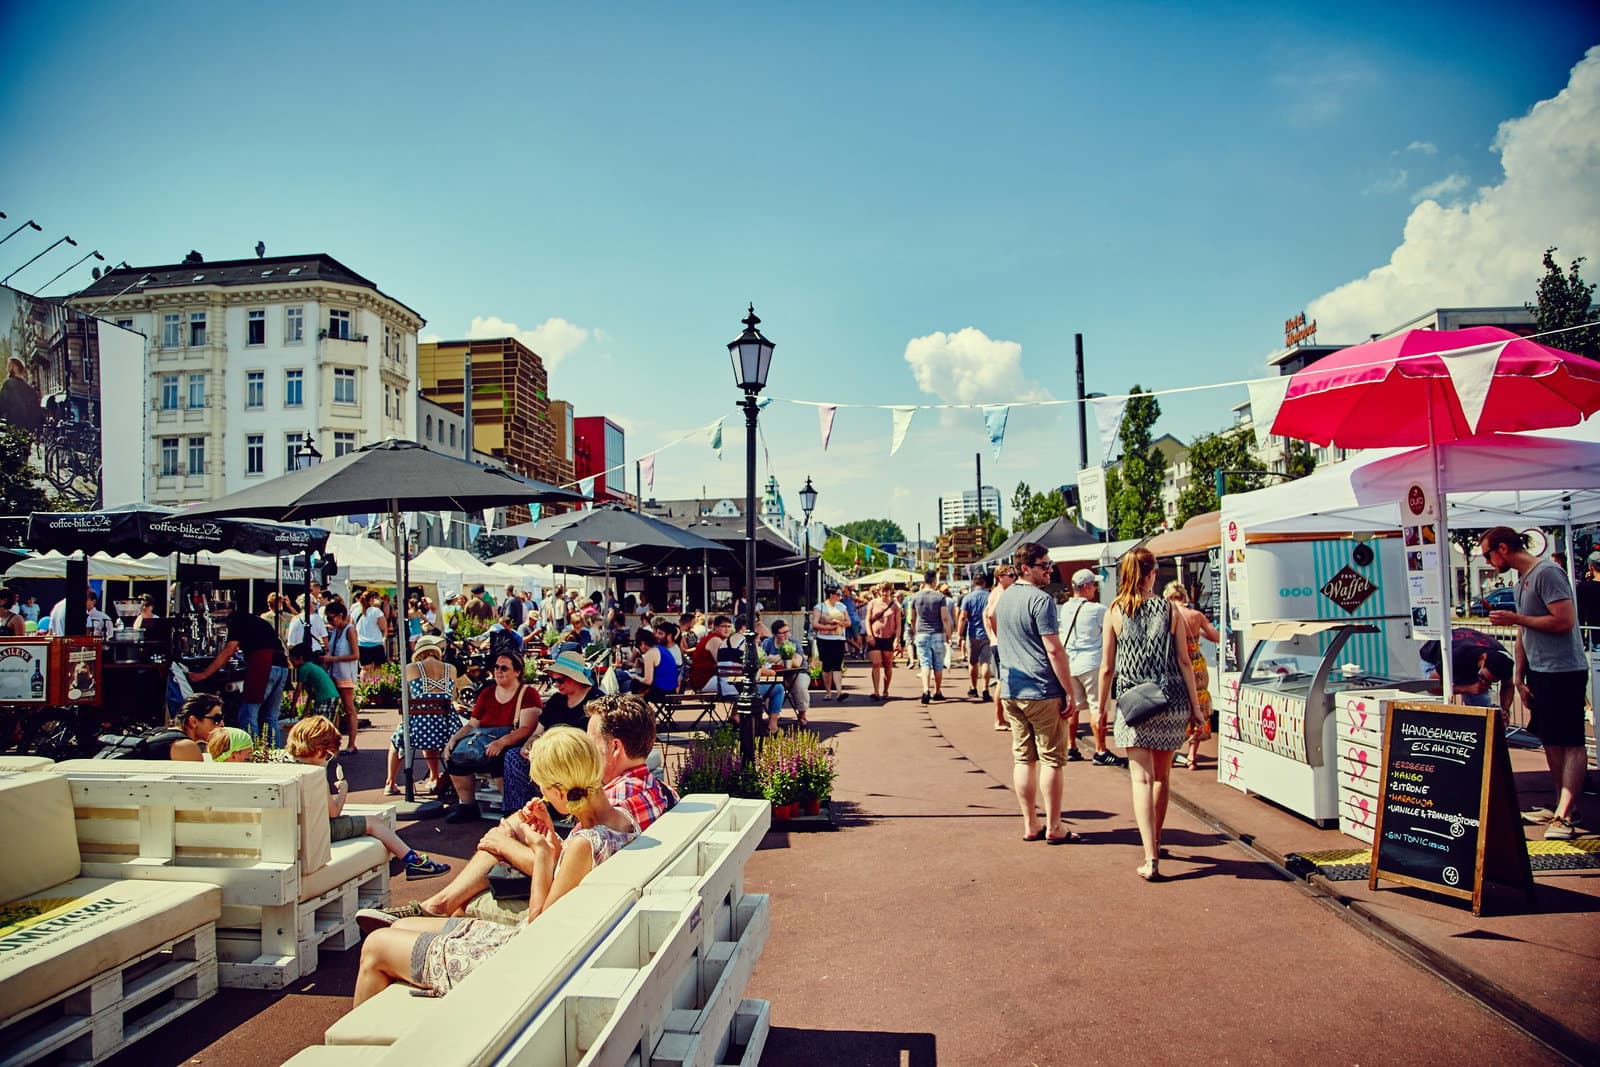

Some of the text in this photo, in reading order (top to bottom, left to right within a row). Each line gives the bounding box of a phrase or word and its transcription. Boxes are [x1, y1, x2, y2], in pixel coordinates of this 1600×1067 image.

[49, 517, 92, 529] coffee-bike
[149, 521, 201, 534] coffee-bike
[1324, 576, 1370, 601] Waffel
[0, 648, 30, 660] AILEYS
[1411, 741, 1471, 759] EIS AM STIEL
[1387, 830, 1402, 841] GIN
[1402, 832, 1429, 847] TONIC
